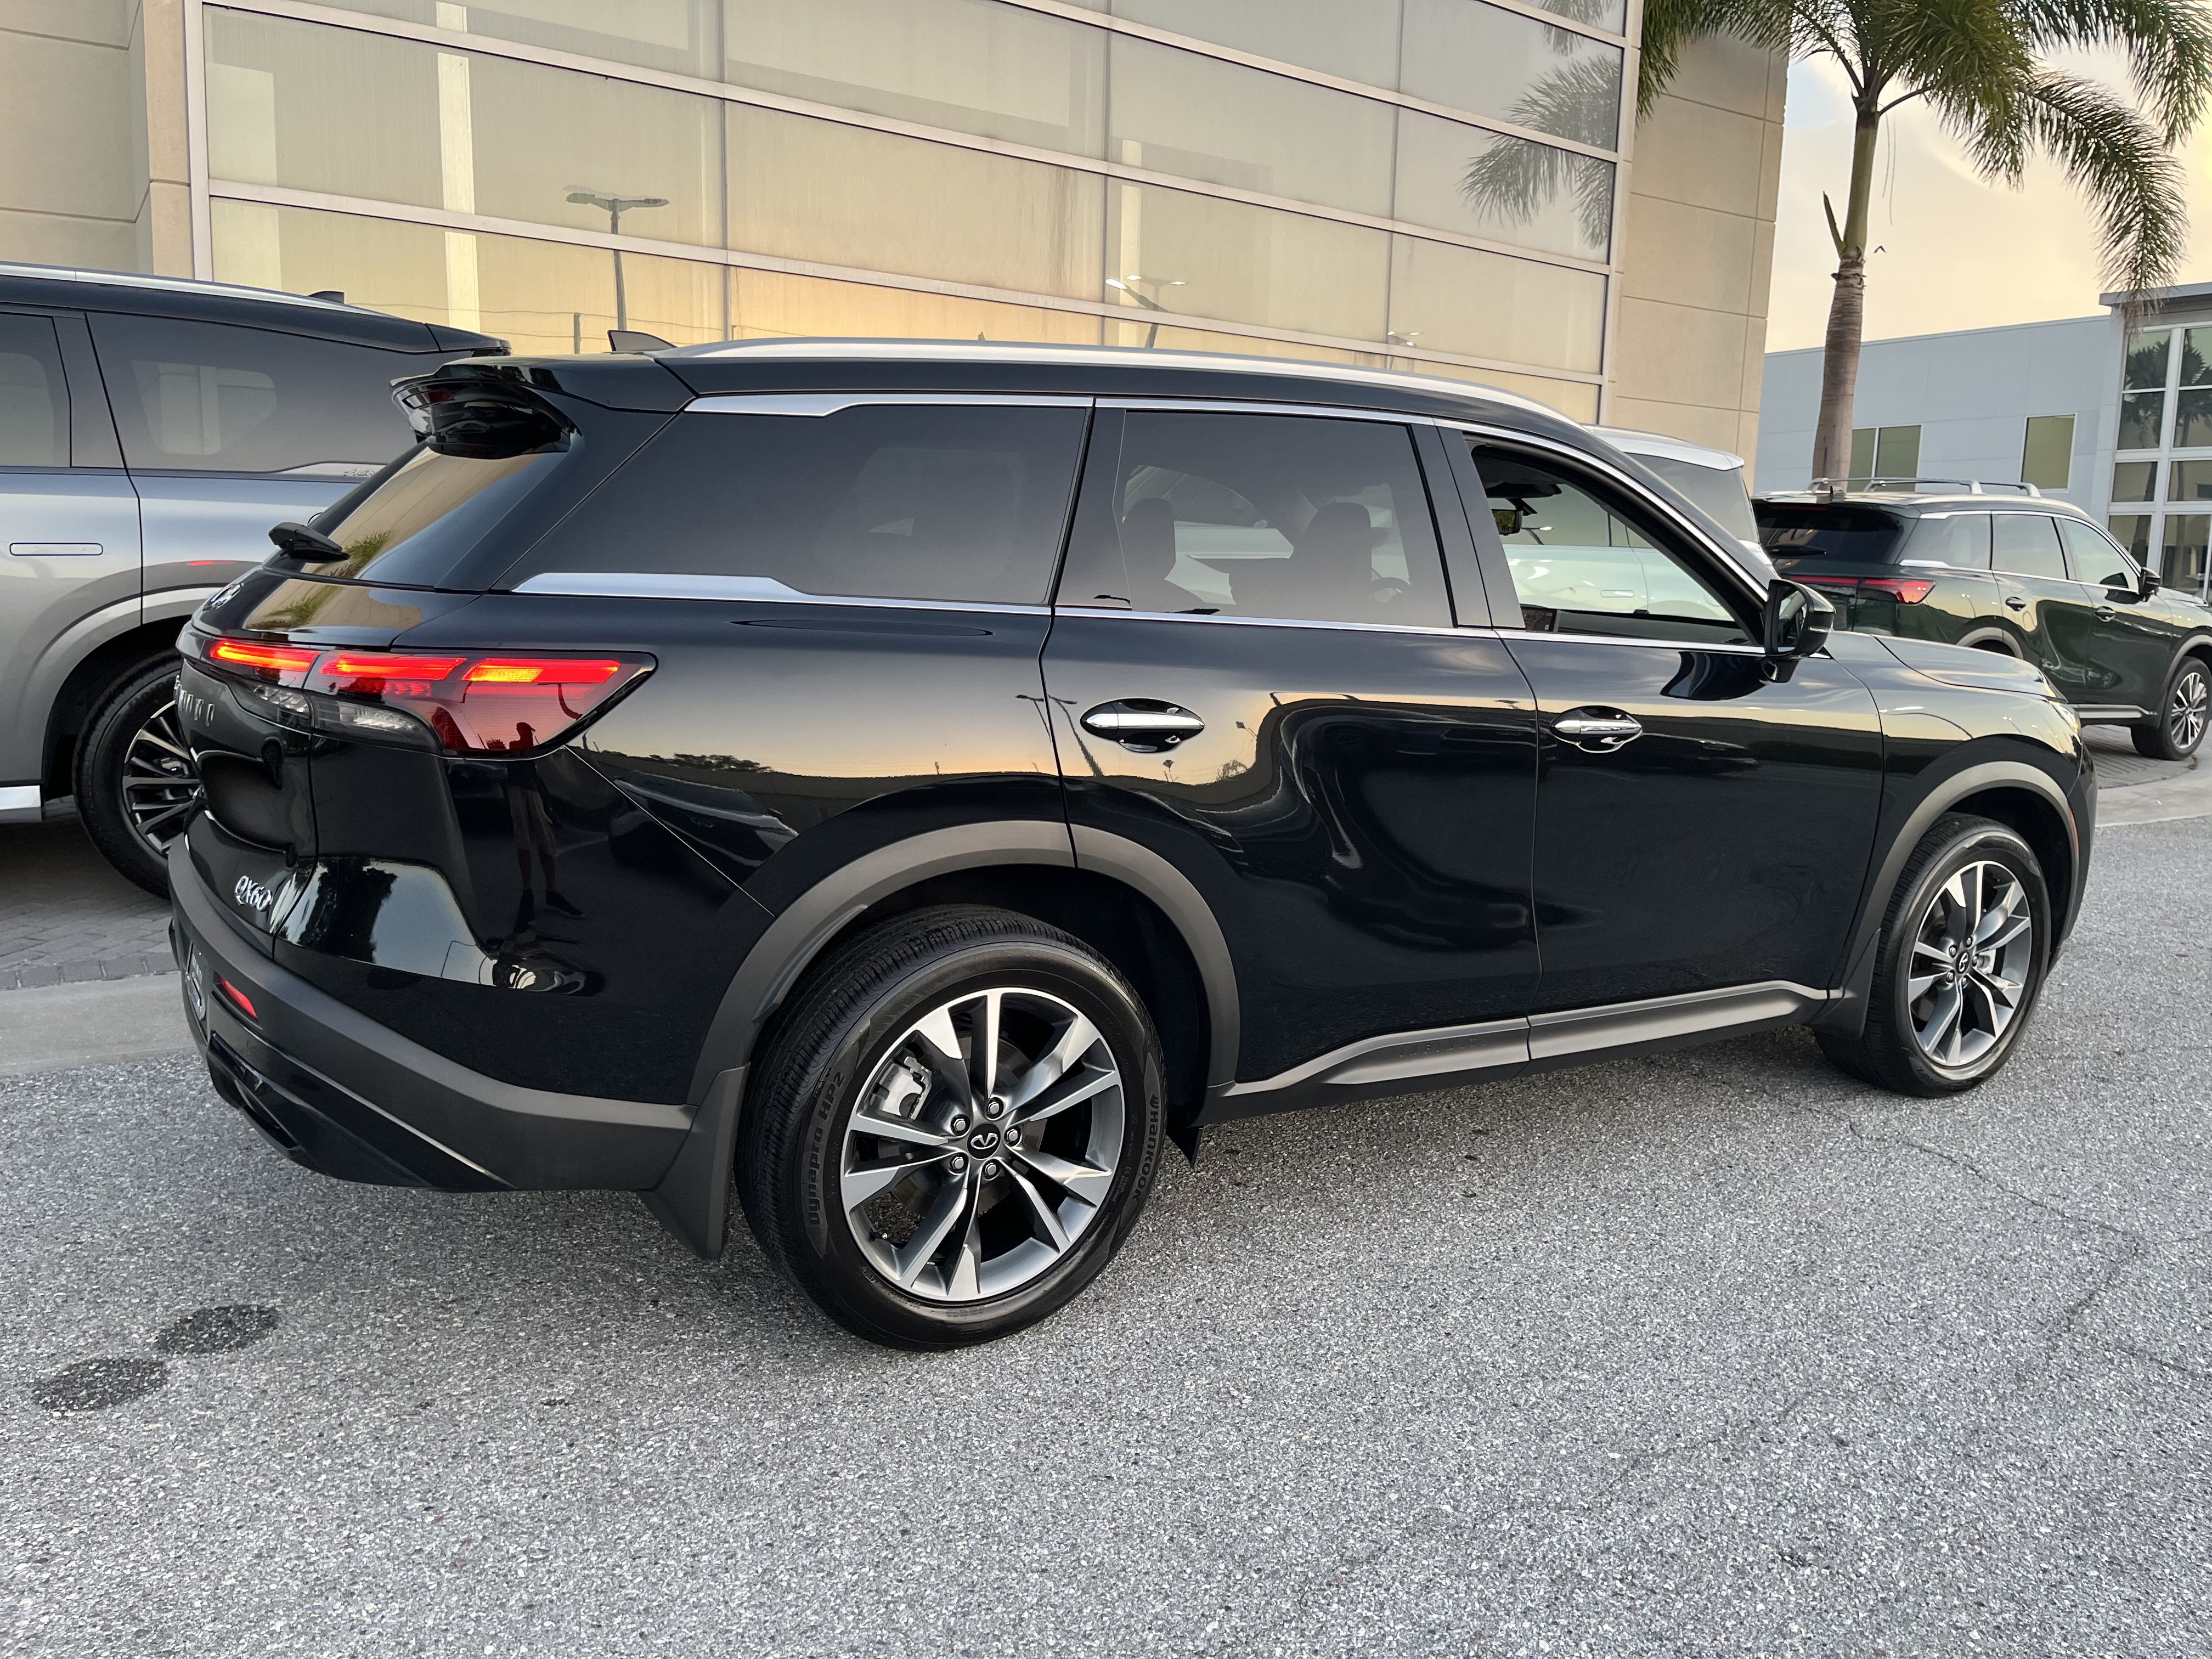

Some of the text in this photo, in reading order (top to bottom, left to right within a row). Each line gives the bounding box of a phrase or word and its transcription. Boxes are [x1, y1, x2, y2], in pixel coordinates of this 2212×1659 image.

[235, 874, 272, 911] QX60
[808, 1126, 823, 1226] Dynapro
[817, 1071, 845, 1121] HP2
[1132, 1110, 1159, 1203] Hankook
